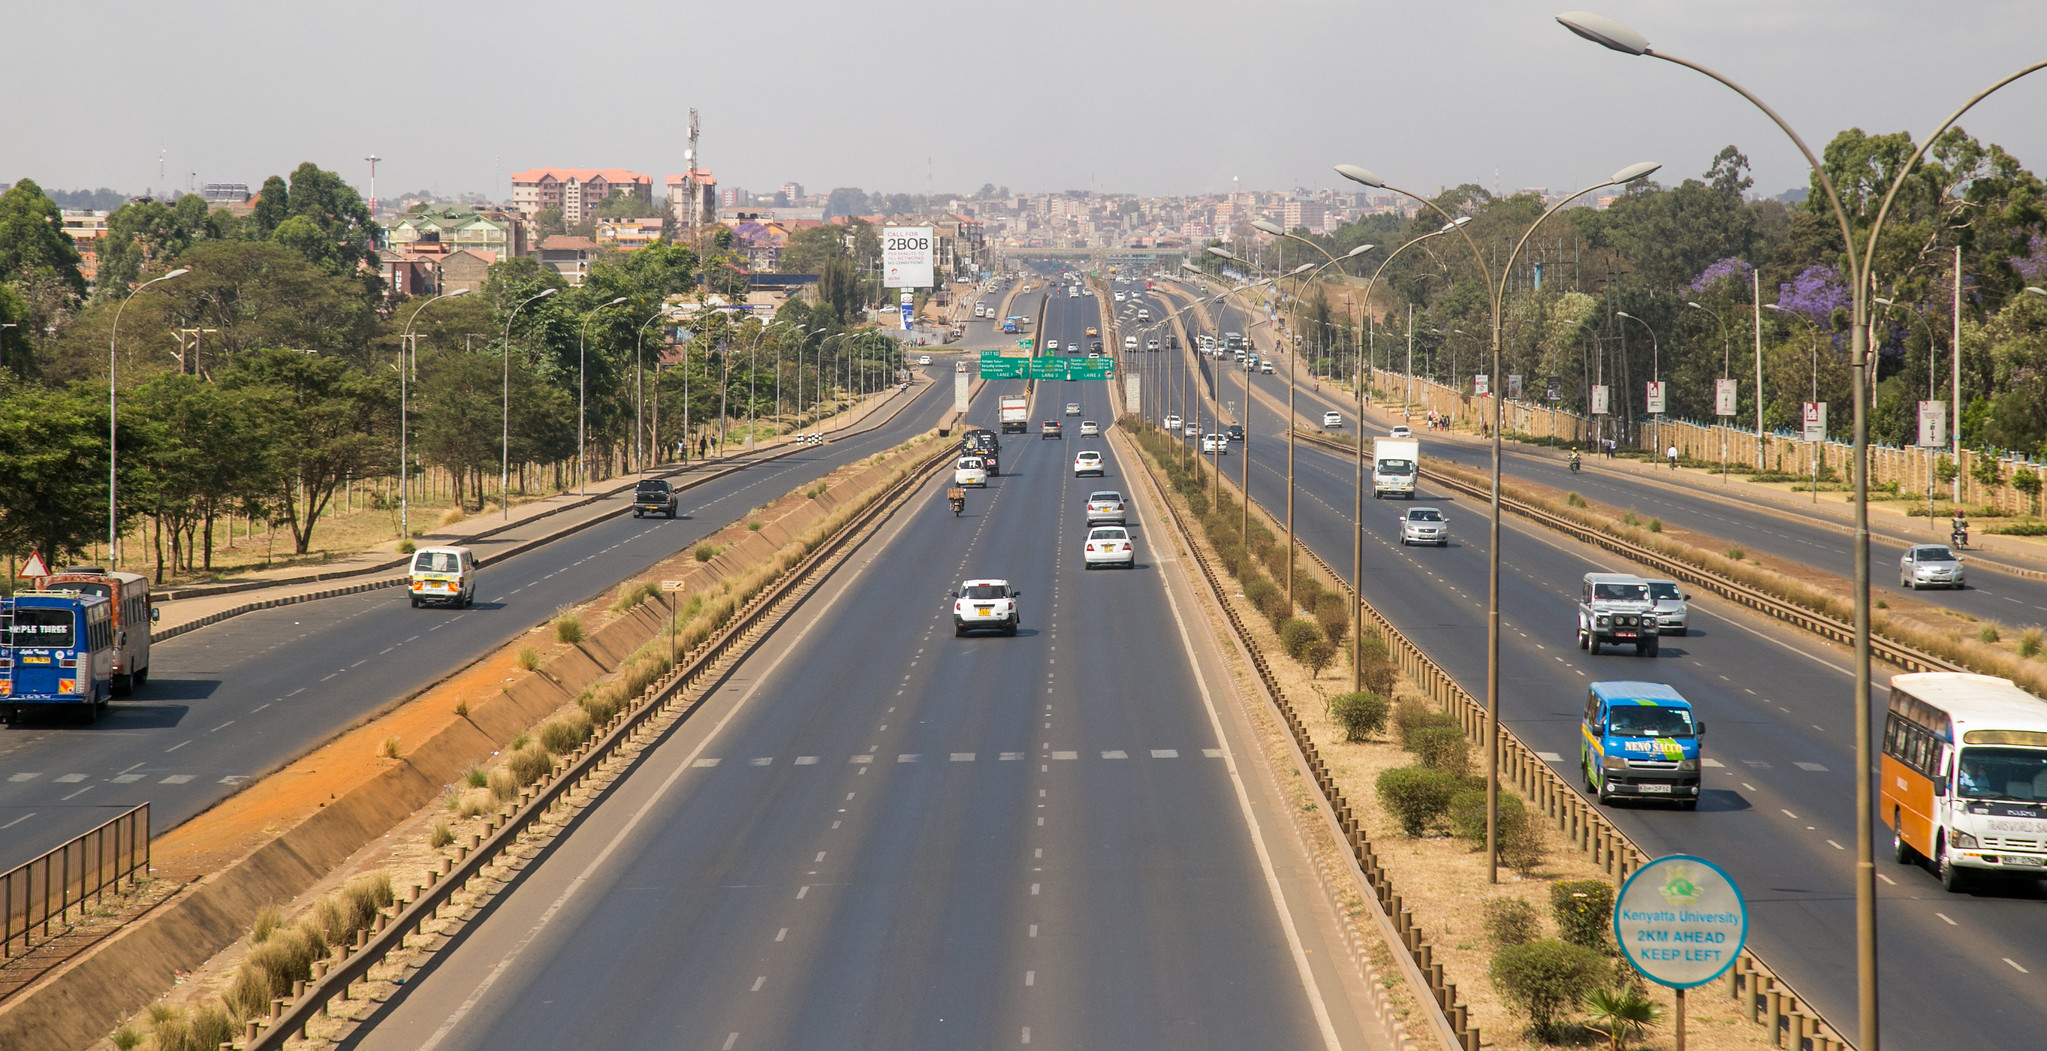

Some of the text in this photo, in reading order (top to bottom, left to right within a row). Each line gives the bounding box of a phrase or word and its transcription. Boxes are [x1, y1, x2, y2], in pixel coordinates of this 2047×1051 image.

[887, 238, 928, 250] 2BOB
[40, 625, 67, 633] THREE
[1624, 741, 1682, 753] NENO SACCO
[1623, 909, 1739, 927] Kenyatta University
[1637, 930, 1725, 944] 2KM AHEAD
[1641, 948, 1722, 962] KEEP LEFT
